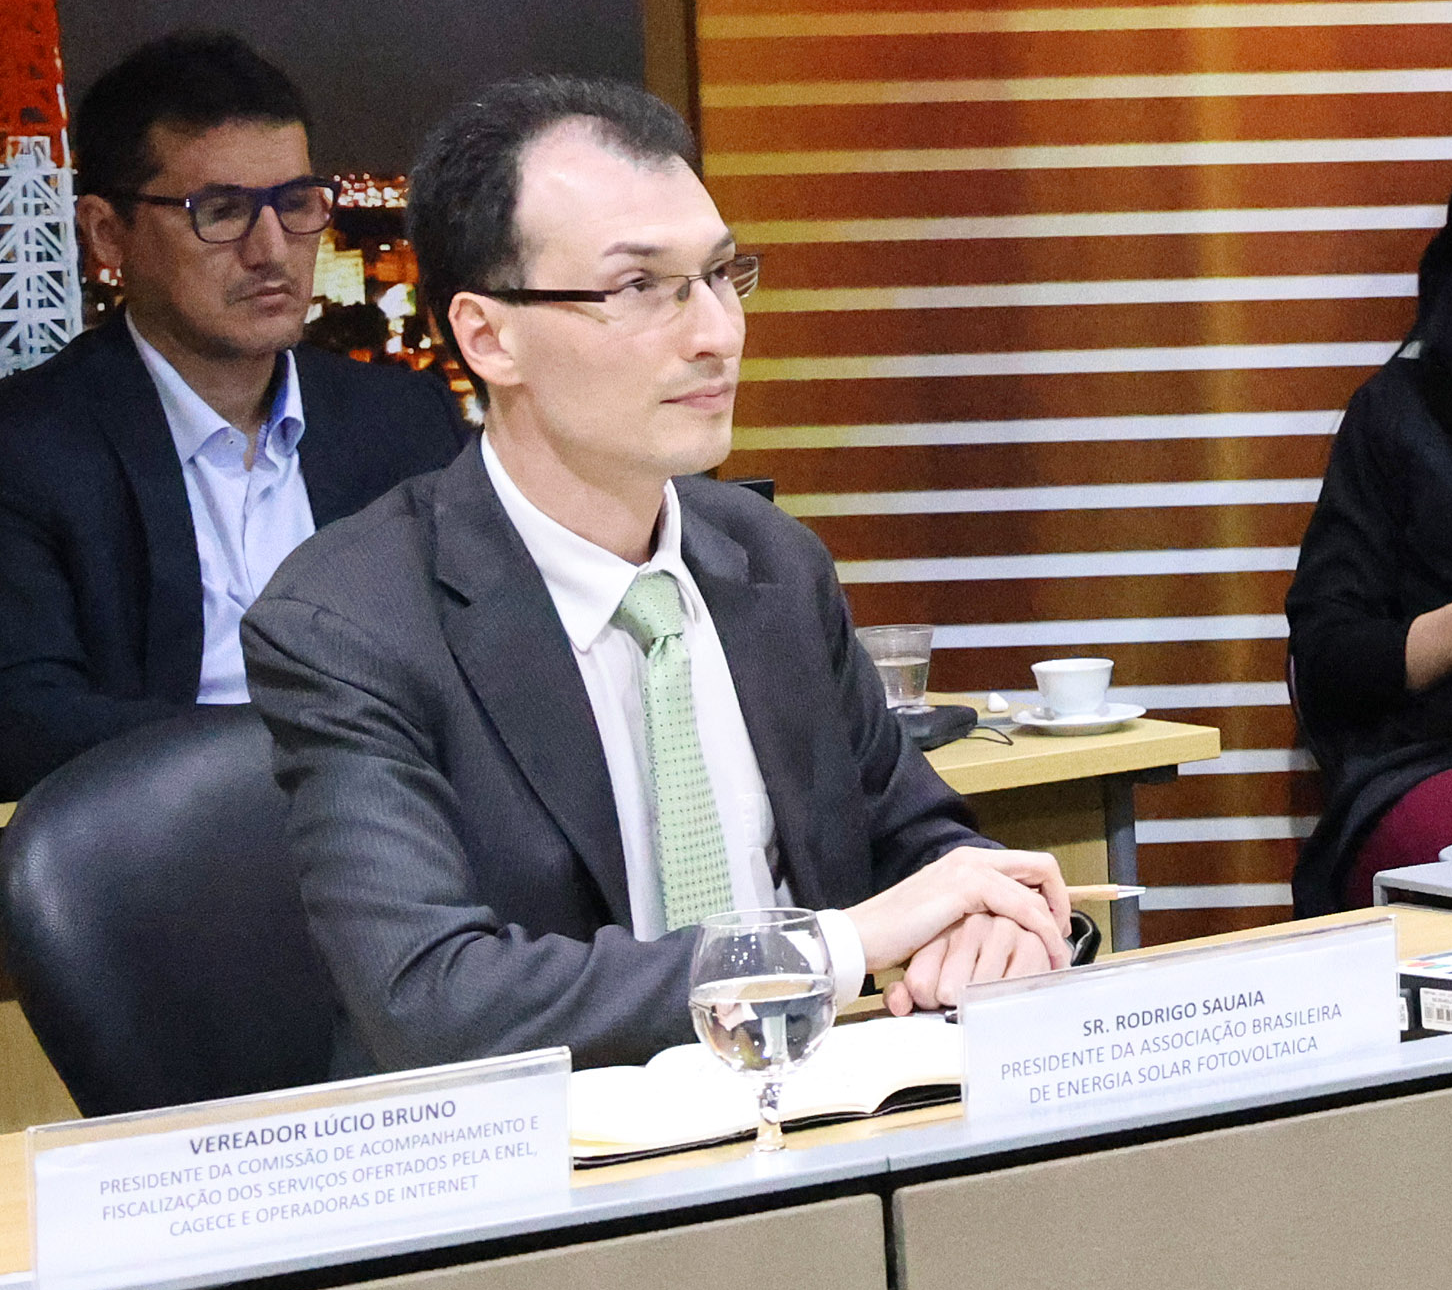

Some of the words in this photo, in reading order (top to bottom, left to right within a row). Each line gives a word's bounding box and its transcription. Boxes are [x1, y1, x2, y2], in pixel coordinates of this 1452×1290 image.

[1002, 1048, 1104, 1080] PRESIDENTE
[1112, 1042, 1134, 1061] DA
[1140, 1021, 1245, 1055] ASSOCIAÇÃO
[1253, 1003, 1342, 1034] BRASILEIRA
[1083, 1019, 1109, 1036] SR.
[1117, 1003, 1197, 1031] RODRIGO
[1203, 991, 1264, 1016] SAUAIA
[1030, 1085, 1050, 1103] DE
[1057, 1071, 1133, 1099] ENERGIA
[1138, 1060, 1191, 1084] SOLAR
[1197, 1036, 1317, 1073] FOTOVOLTAICA
[100, 1167, 203, 1195] PRESIDENTE
[209, 1164, 231, 1180] DA
[238, 1148, 328, 1174] COMISSÃO
[335, 1146, 355, 1161] DE
[360, 1119, 524, 1159] ACOMPANHAMENTO
[531, 1116, 538, 1129] E
[190, 1124, 307, 1155] VEREADOR
[315, 1113, 374, 1137] LÚCIO
[383, 1101, 456, 1127] BRUNO
[103, 1189, 222, 1220] FISCALIZAÇÃO
[228, 1184, 263, 1202] DOS
[269, 1172, 347, 1196] SERVIÇOS
[353, 1156, 447, 1184] OFERTADOS
[452, 1149, 489, 1168] PELA
[496, 1142, 537, 1162] ENEL,
[170, 1213, 237, 1237] CAGECE
[242, 1212, 251, 1225] E
[257, 1192, 369, 1224] OPERADORAS
[375, 1189, 395, 1205] DE
[401, 1175, 478, 1201] INTERNET
